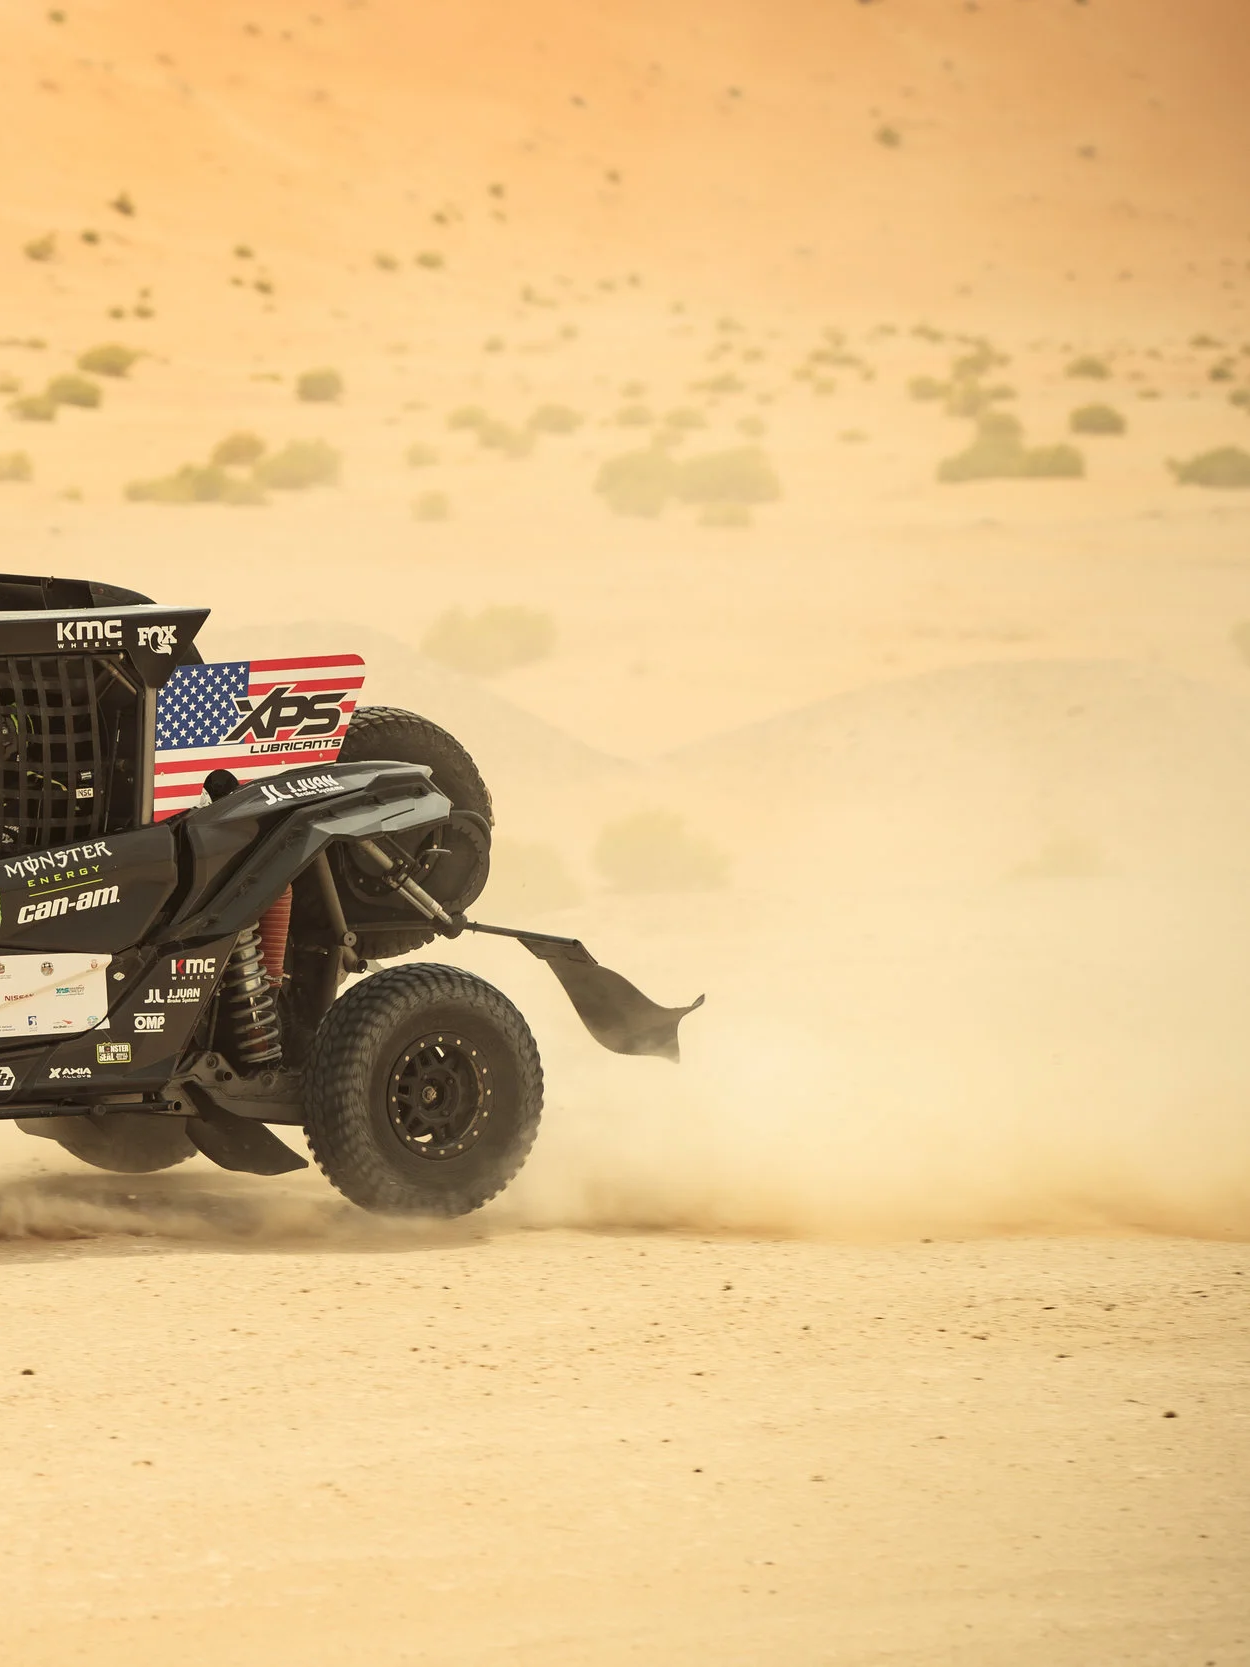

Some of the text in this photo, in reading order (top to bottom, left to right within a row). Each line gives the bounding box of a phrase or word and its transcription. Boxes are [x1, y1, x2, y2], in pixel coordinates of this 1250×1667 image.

[57, 640, 123, 649] WHEELS
[137, 625, 178, 655] FOX
[223, 686, 348, 742] XPS
[250, 738, 342, 754] LUBRICANTS
[27, 864, 100, 888] ENERGY
[134, 1016, 166, 1030] OMP
[61, 1067, 92, 1075] AXIA
